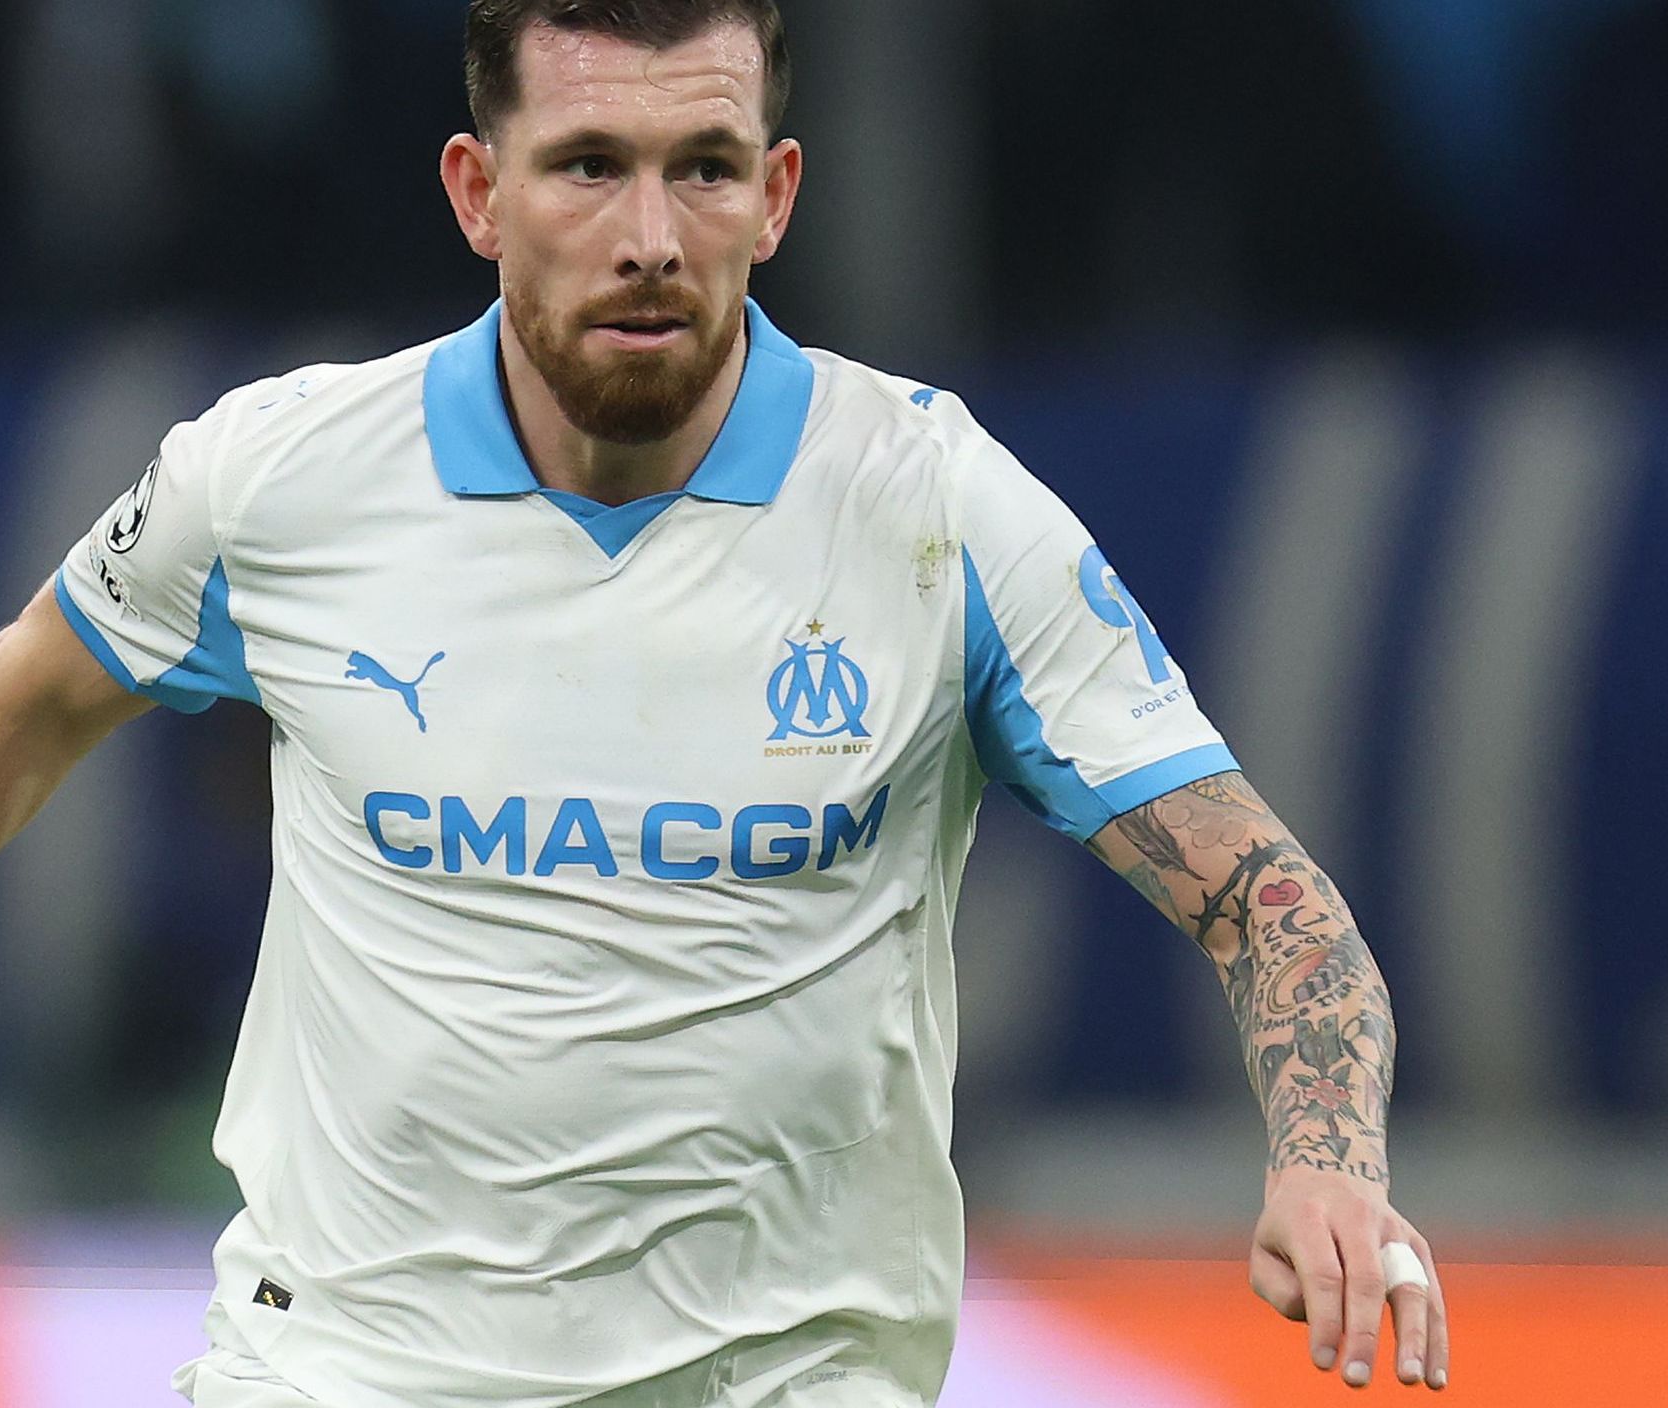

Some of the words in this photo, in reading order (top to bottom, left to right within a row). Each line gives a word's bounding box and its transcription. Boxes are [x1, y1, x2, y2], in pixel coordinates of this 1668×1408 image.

[764, 746, 813, 758] DROIT
[815, 745, 837, 756] AU
[841, 743, 873, 756] BUT
[363, 790, 619, 878] CMA
[640, 783, 891, 881] CGM
